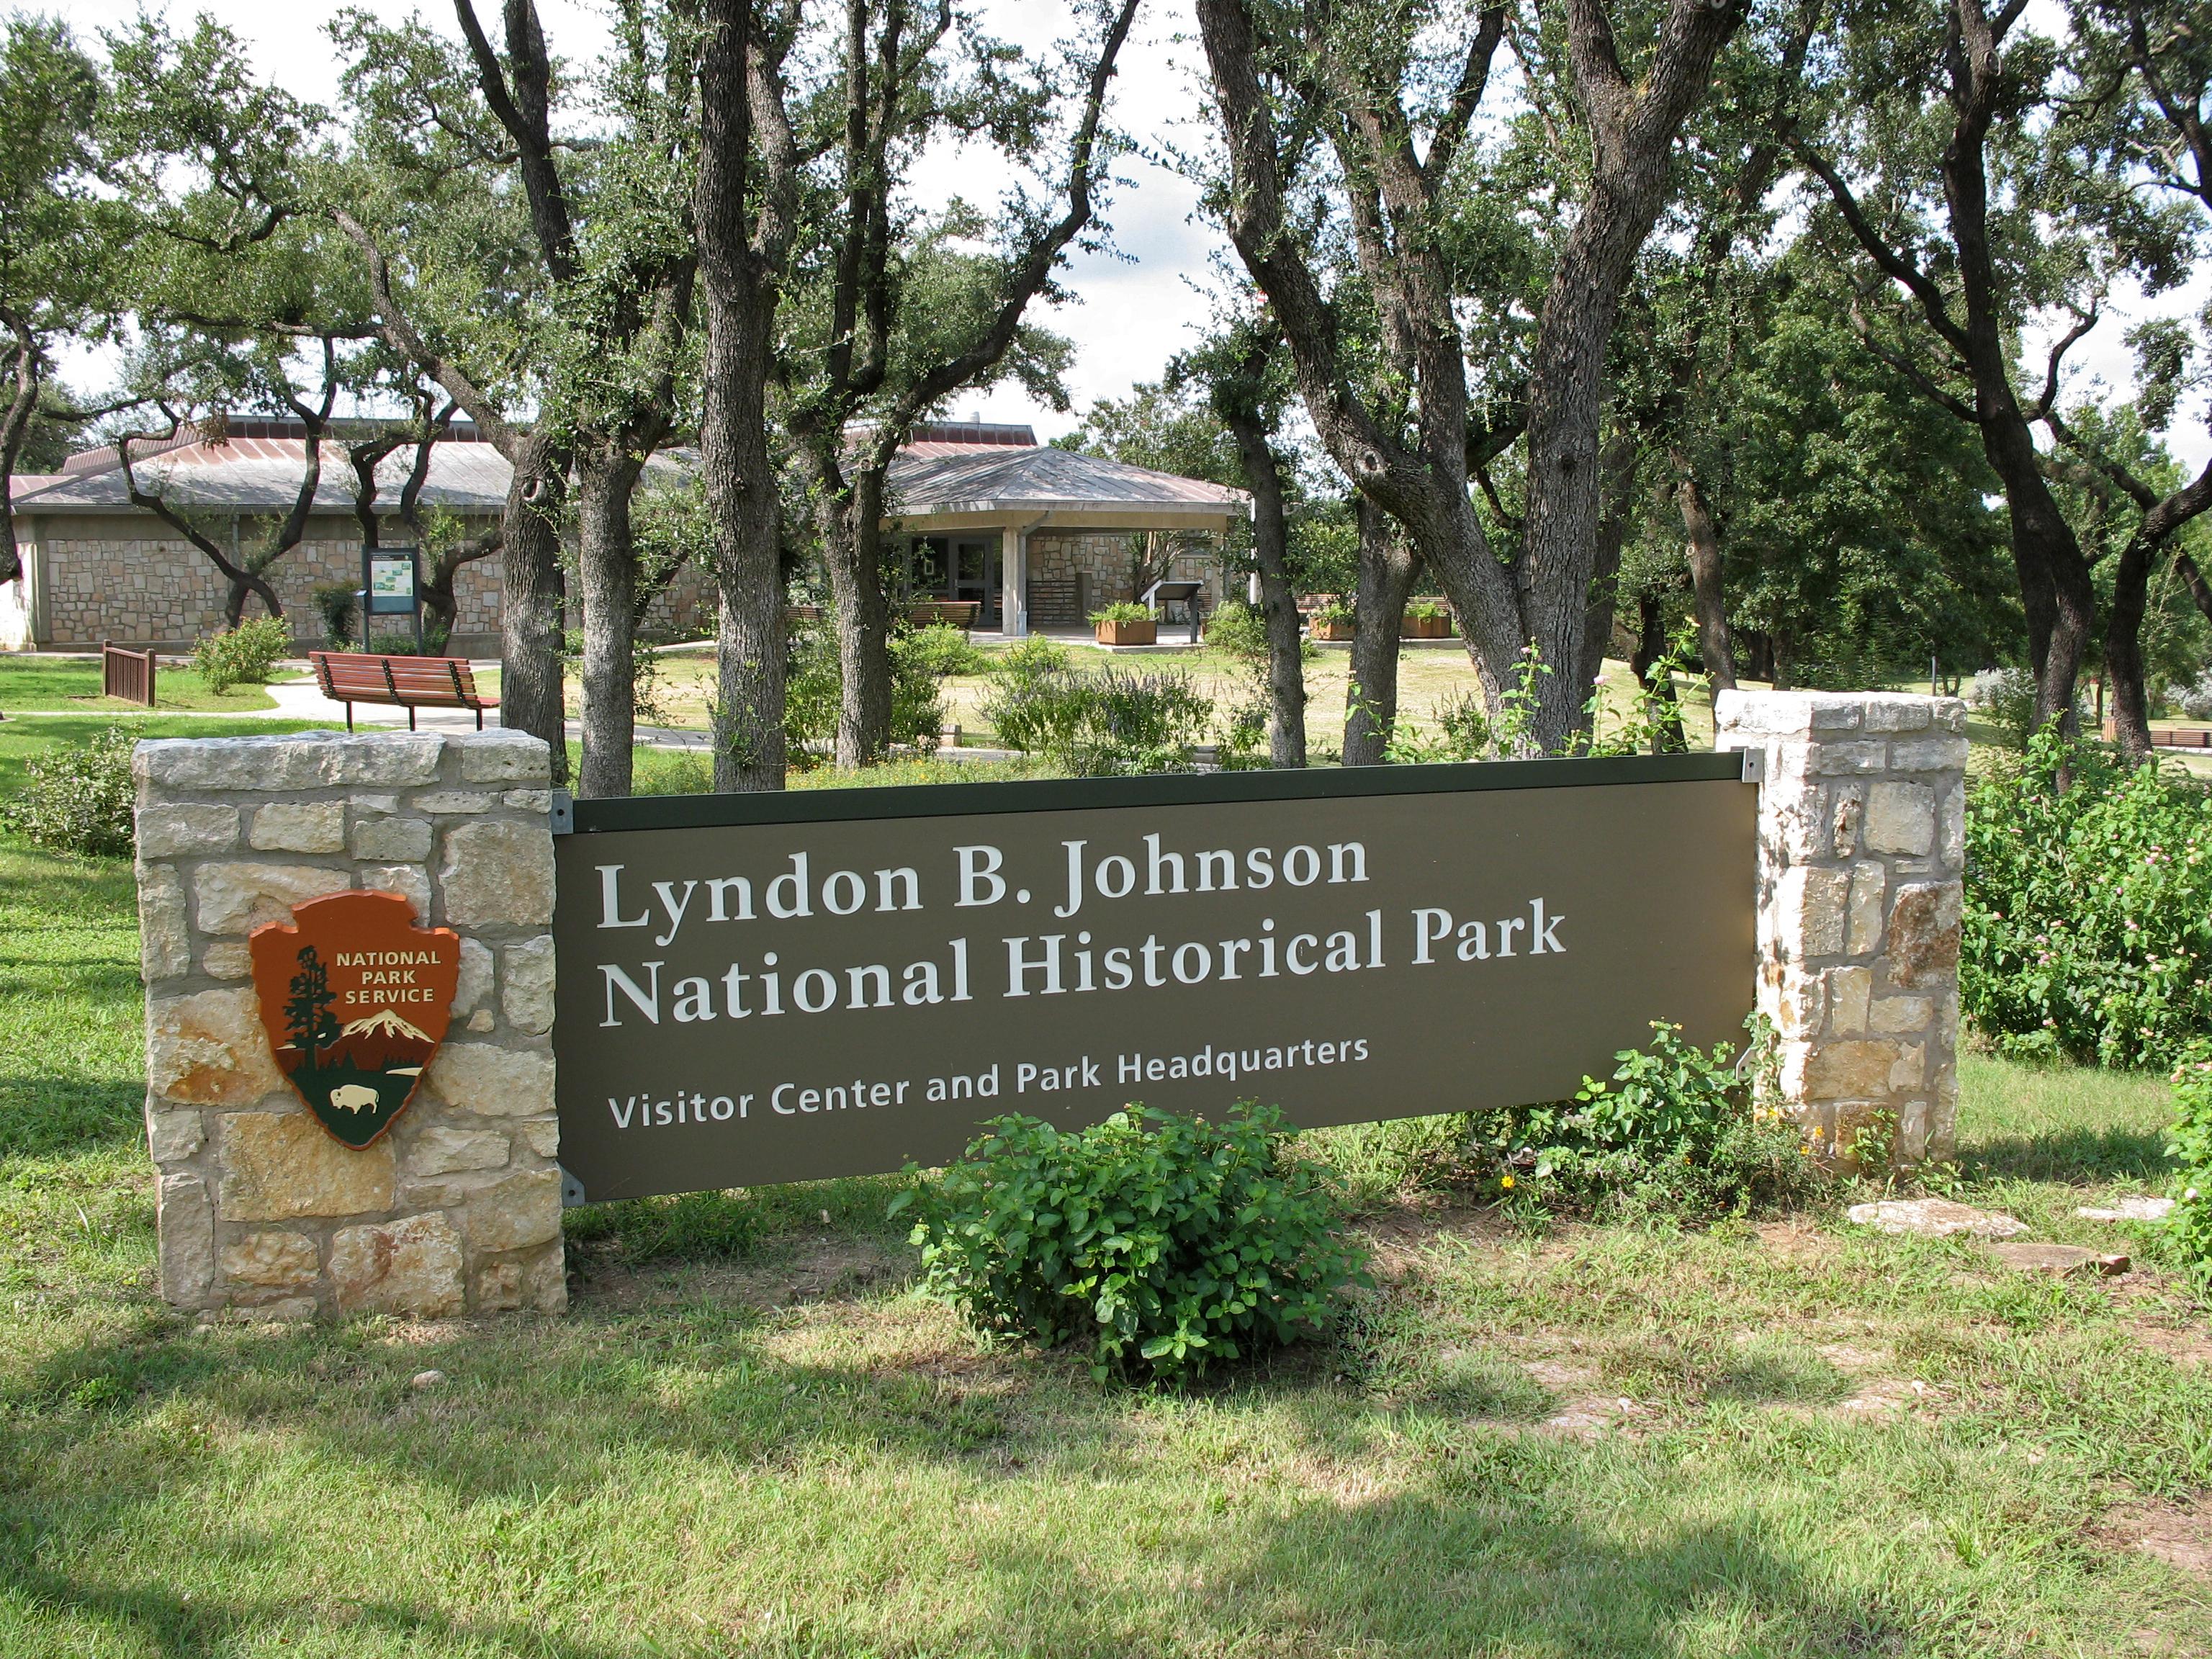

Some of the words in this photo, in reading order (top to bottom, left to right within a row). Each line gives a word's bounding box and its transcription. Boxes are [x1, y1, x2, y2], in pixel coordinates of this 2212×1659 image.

[594, 851, 924, 947] Lyndon
[952, 845, 1030, 907] B.
[1053, 832, 1370, 918] Johnson
[336, 950, 441, 966] NATIONAL
[361, 970, 415, 985] PARK
[597, 938, 974, 1028] National
[1002, 909, 1386, 997] Historical
[1411, 897, 1567, 965] Park
[345, 989, 433, 1004] SERVICE
[608, 1090, 754, 1128] Visitor
[771, 1079, 909, 1115] Center
[926, 1064, 999, 1102] and
[1017, 1056, 1102, 1093] Park
[1118, 1038, 1368, 1084] Headquarters
